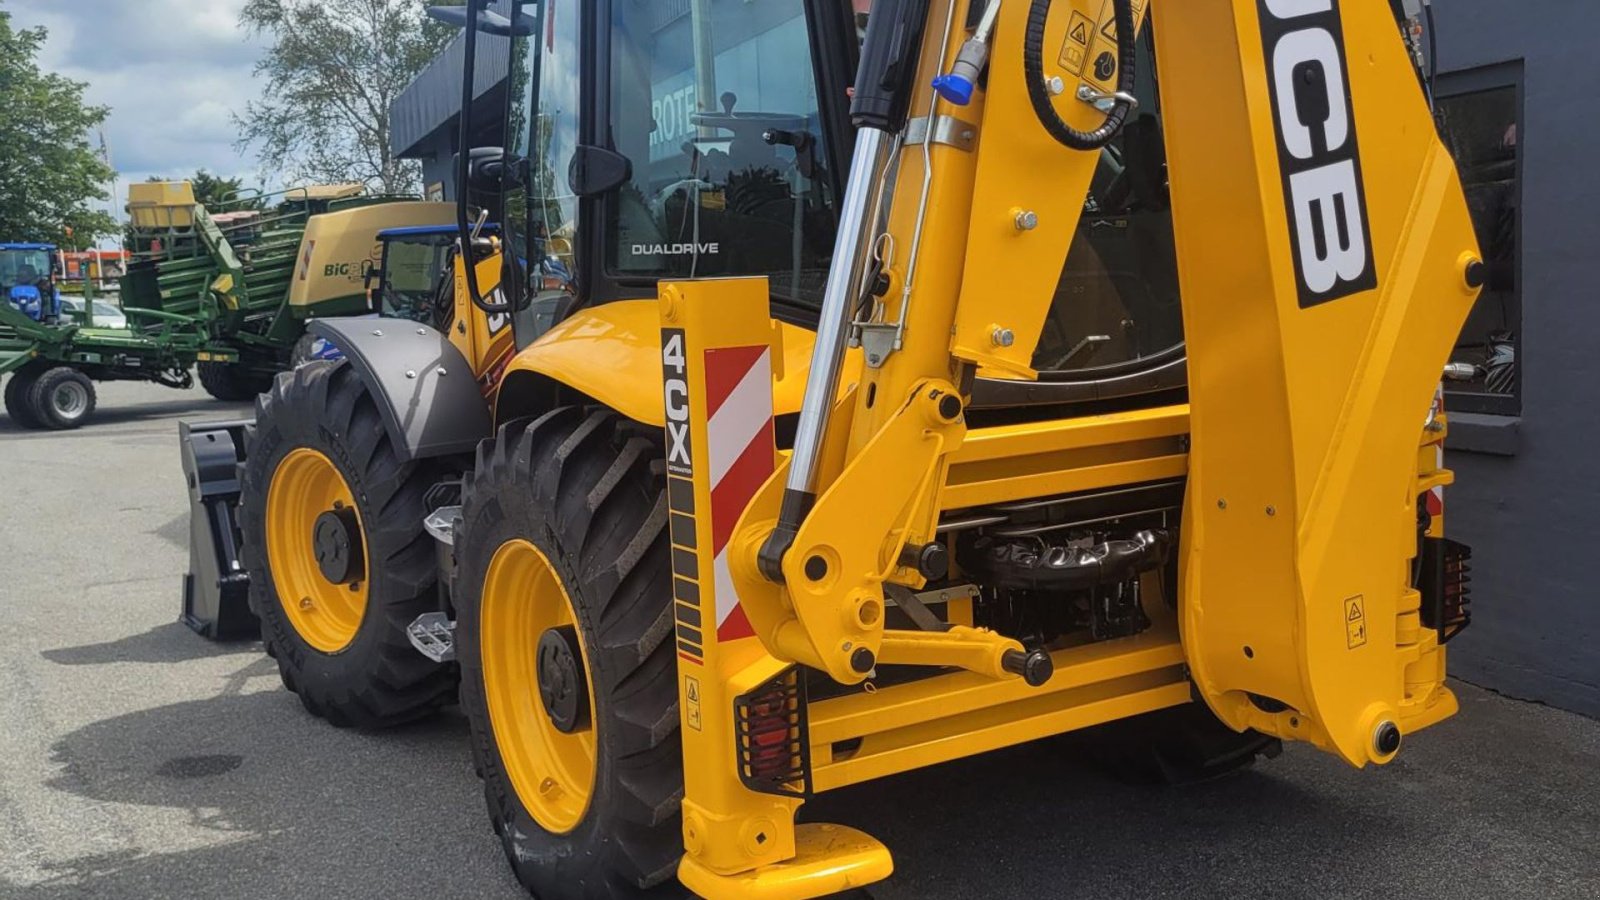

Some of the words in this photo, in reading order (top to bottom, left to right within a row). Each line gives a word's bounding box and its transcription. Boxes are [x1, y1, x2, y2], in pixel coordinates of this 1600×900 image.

[1264, 0, 1366, 294] CB
[632, 243, 719, 254] DUALDRIVE
[663, 334, 691, 465] 4CX
